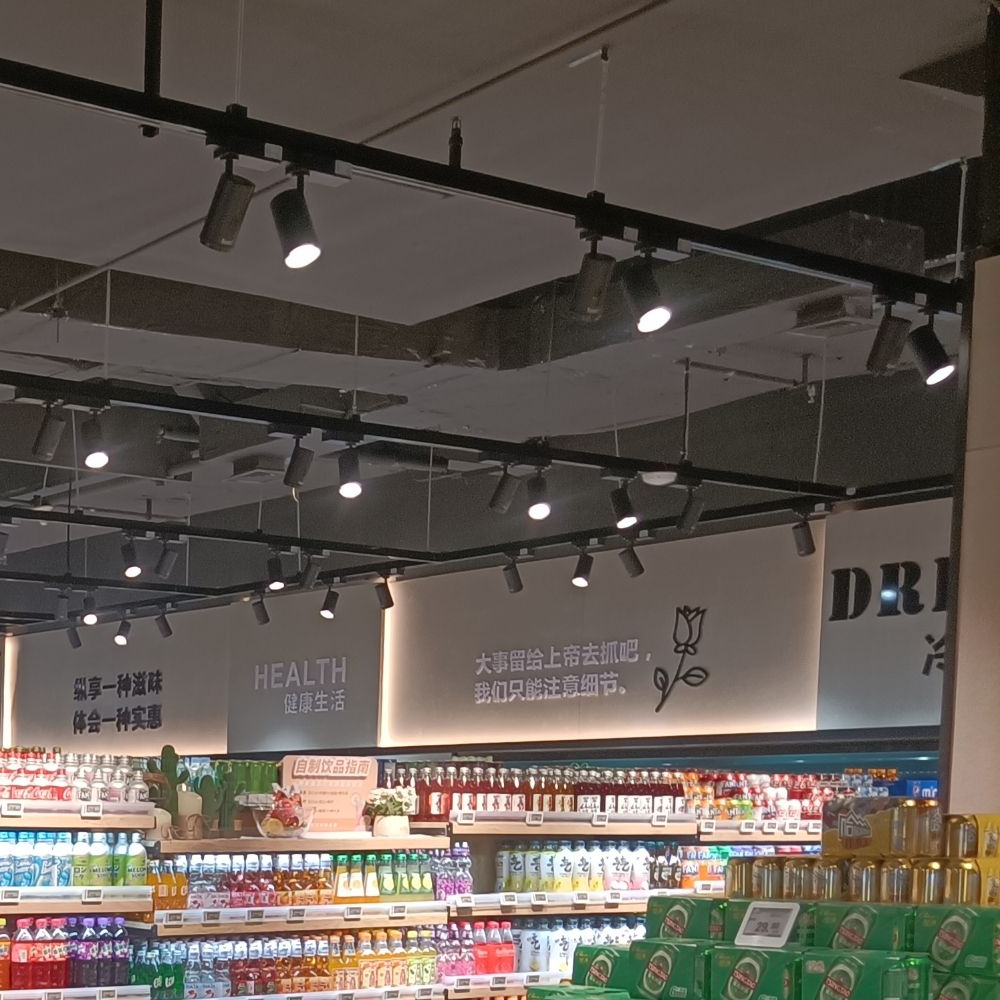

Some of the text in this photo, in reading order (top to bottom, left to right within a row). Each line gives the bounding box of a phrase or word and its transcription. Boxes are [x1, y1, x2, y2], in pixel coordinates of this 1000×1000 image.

[73, 670, 163, 701] 纵享一种滋味
[254, 657, 347, 690] HEALTH
[284, 689, 345, 714] 健康生活
[73, 704, 163, 735] 体会一种实惠
[295, 759, 371, 775] 自制饮品指南
